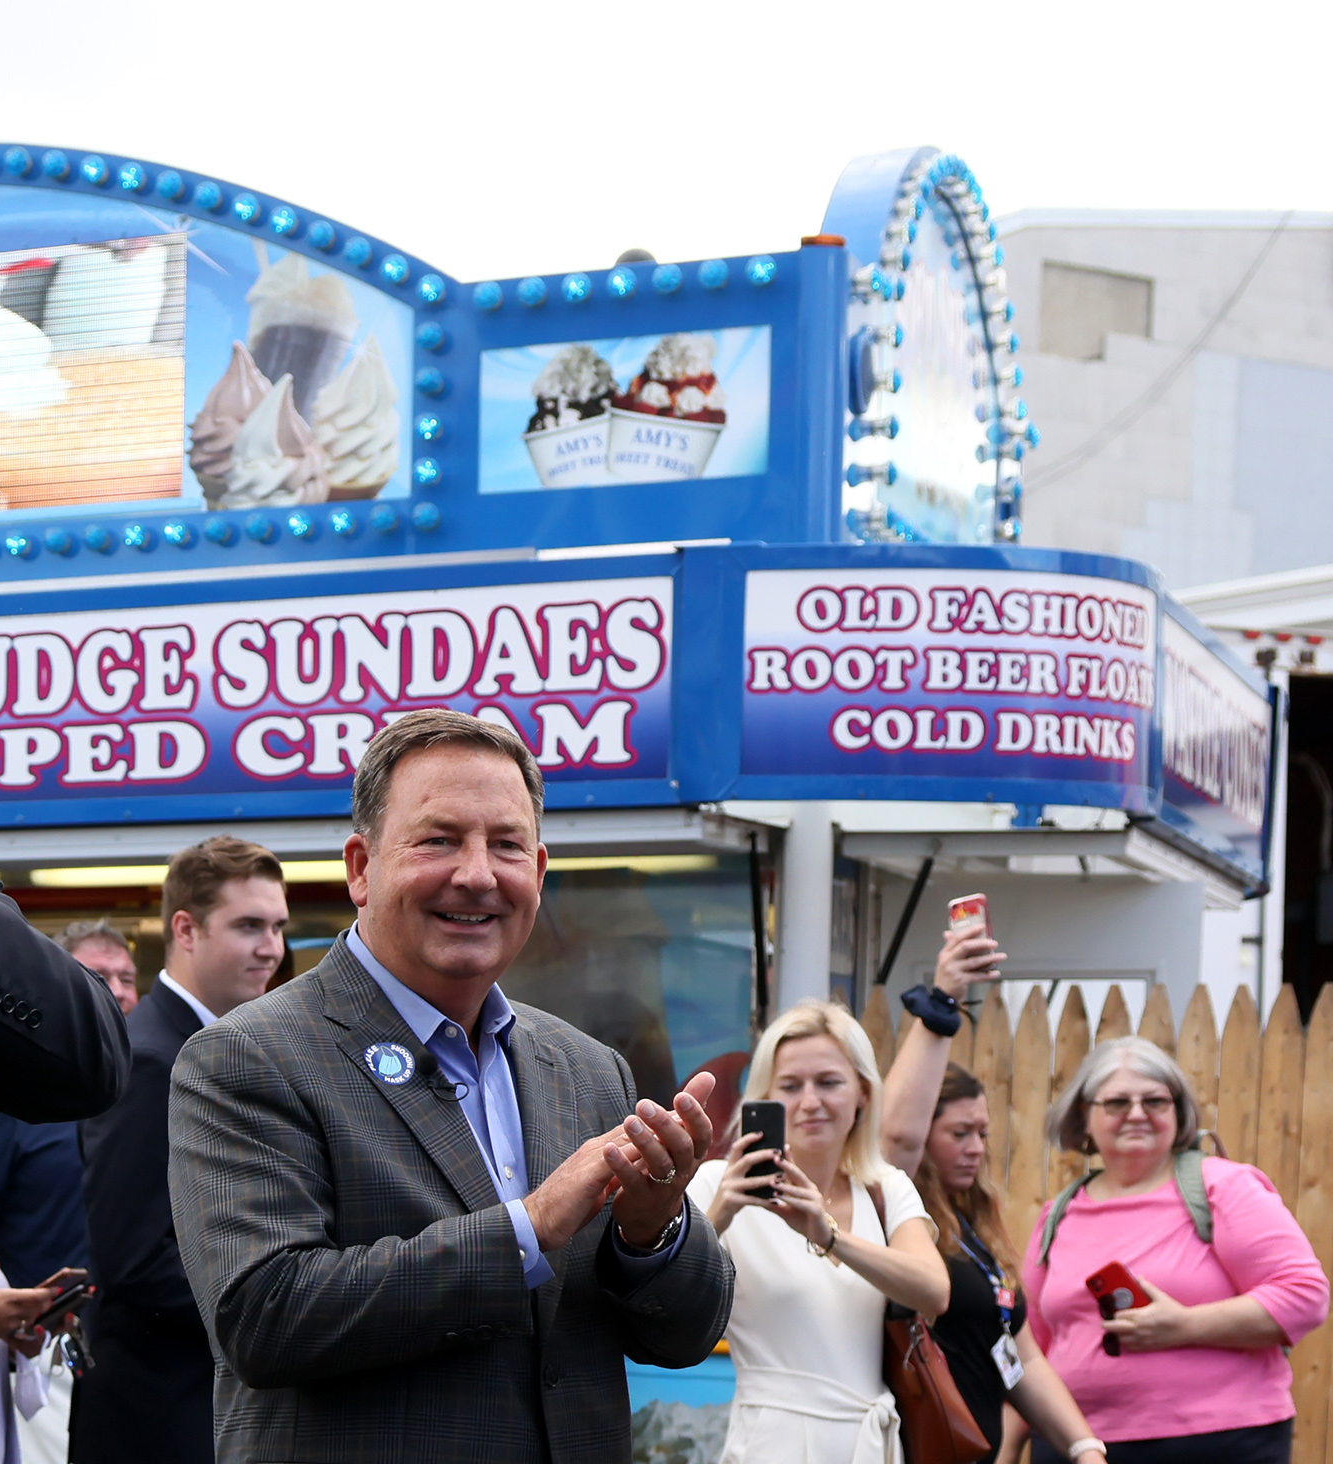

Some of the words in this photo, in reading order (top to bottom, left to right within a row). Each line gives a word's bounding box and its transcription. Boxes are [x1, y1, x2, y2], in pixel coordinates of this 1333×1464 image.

[798, 586, 920, 633] OLD
[929, 586, 1149, 648] FASHIONED
[214, 597, 666, 708] SUNDAES
[747, 647, 917, 692] ROOT
[924, 648, 1060, 696] BEER
[832, 706, 988, 755] COLD
[994, 708, 1137, 762] DRINKS
[364, 1045, 379, 1071] PLEASE
[390, 1044, 414, 1069] INDOORS
[402, 1068, 412, 1078] UP
[384, 1076, 405, 1084] MASK
